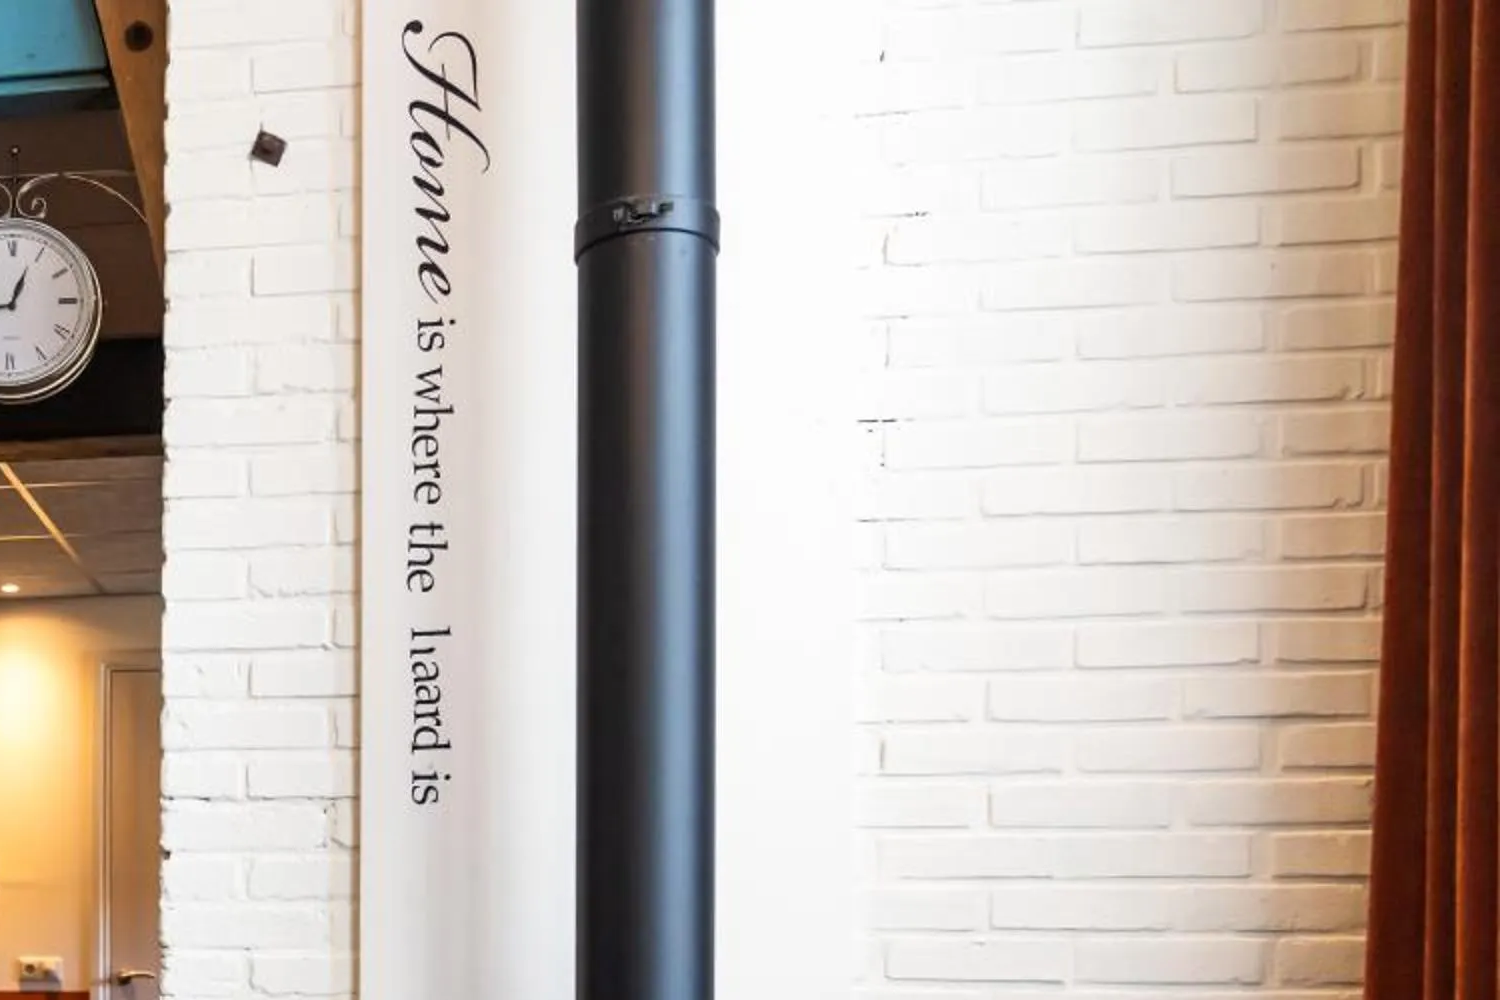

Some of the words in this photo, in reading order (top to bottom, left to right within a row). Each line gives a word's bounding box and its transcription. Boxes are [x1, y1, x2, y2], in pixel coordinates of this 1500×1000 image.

[401, 19, 491, 304] Home
[417, 317, 457, 353] is
[411, 365, 455, 506] where
[406, 522, 449, 593] the
[411, 771, 452, 806] is
